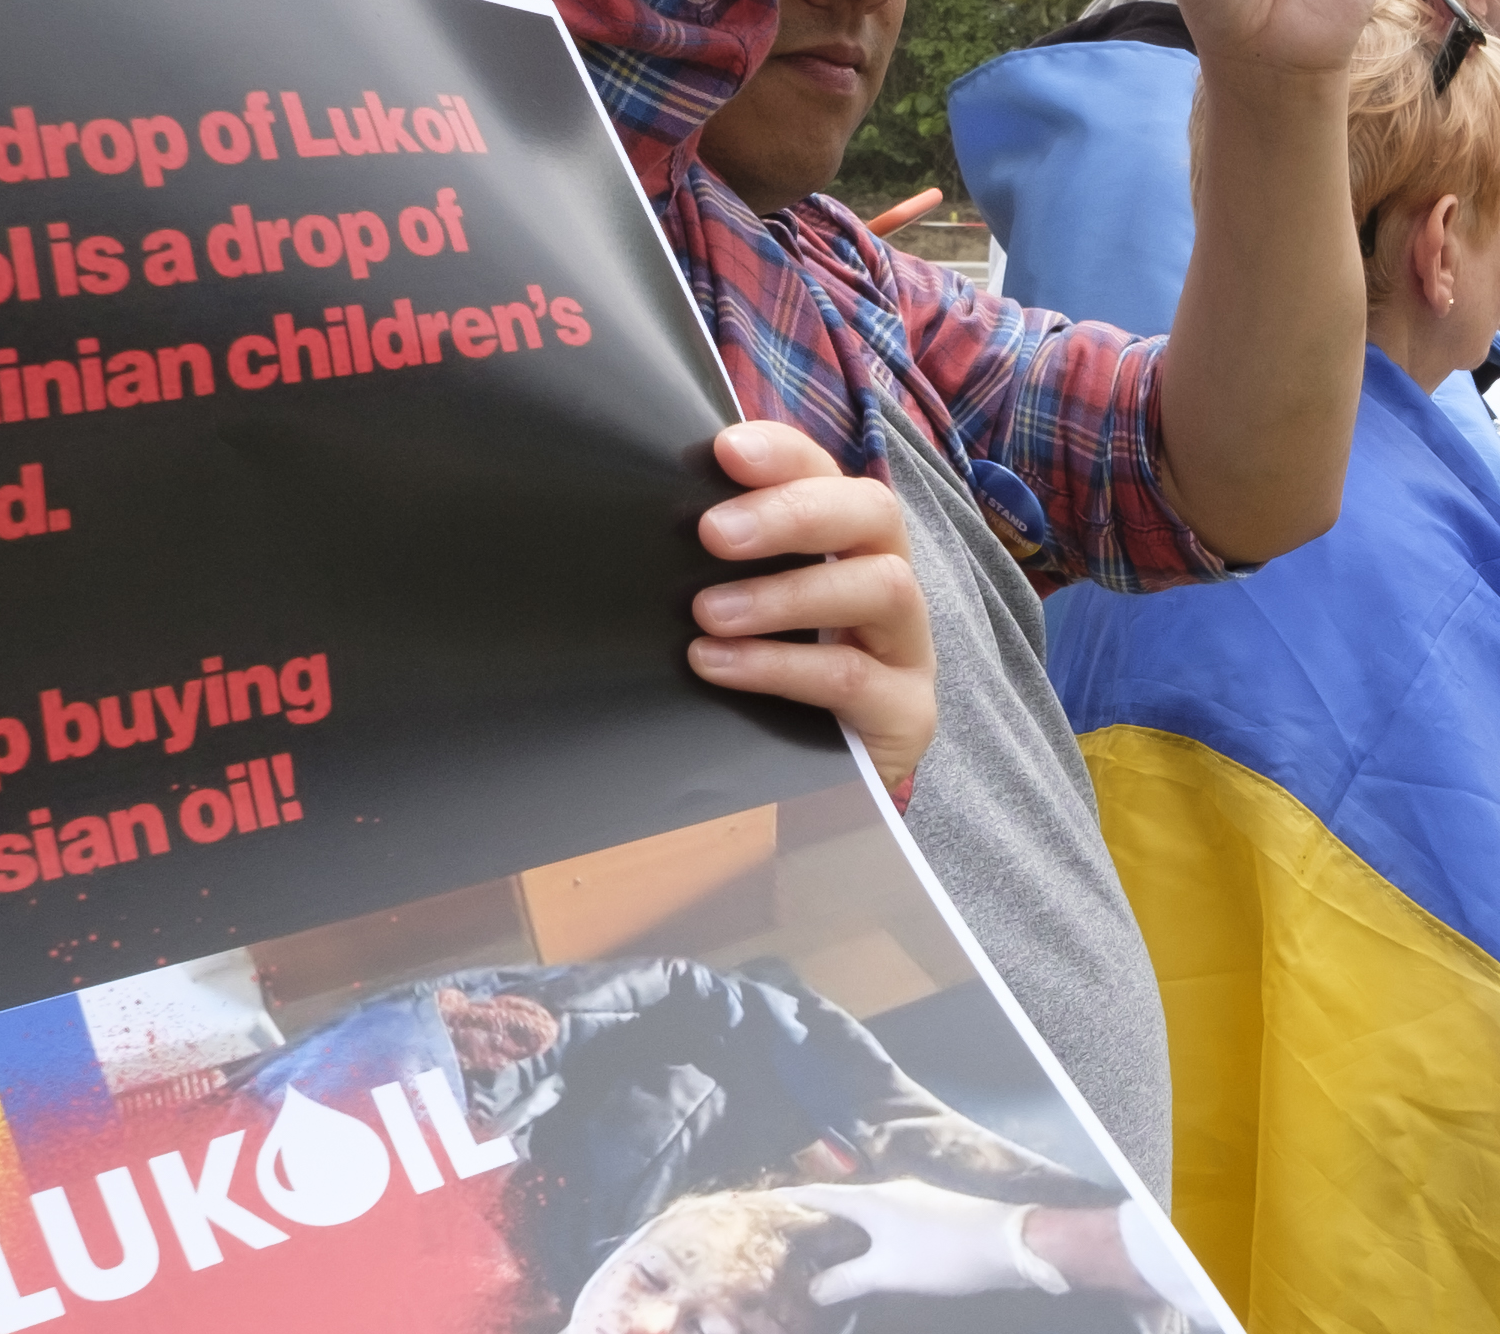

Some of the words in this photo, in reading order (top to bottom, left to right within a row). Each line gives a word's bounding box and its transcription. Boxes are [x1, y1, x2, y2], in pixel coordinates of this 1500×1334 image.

[199, 91, 279, 164] of
[279, 90, 488, 158] Lukoil
[47, 222, 130, 297] is
[141, 228, 198, 287] a
[206, 204, 391, 280] drop
[398, 187, 470, 257] of
[226, 284, 593, 391] children's
[38, 652, 333, 763] buying
[178, 752, 305, 845] oil!
